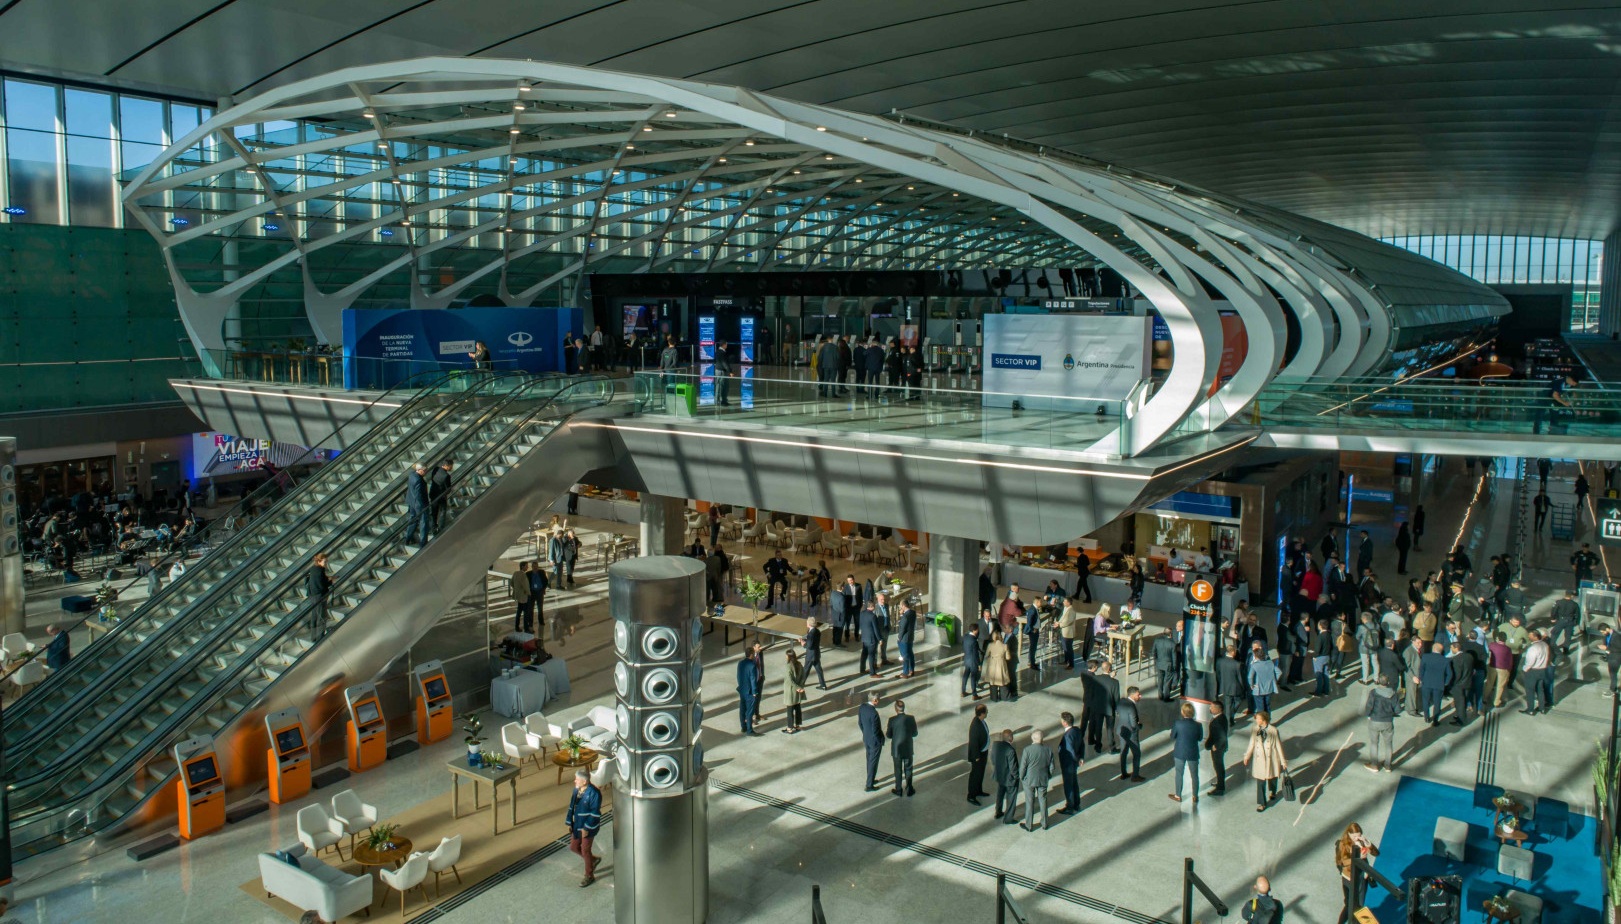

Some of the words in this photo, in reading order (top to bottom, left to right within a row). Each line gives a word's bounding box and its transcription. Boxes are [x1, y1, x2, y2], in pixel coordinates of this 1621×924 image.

[995, 357, 1023, 366] SECTOR
[1025, 358, 1038, 366] VIP
[1077, 360, 1109, 369] Argentina
[217, 435, 229, 443] TU
[218, 439, 270, 455] VIAJE
[219, 451, 258, 462] EMPIEZA
[1197, 583, 1207, 597] F
